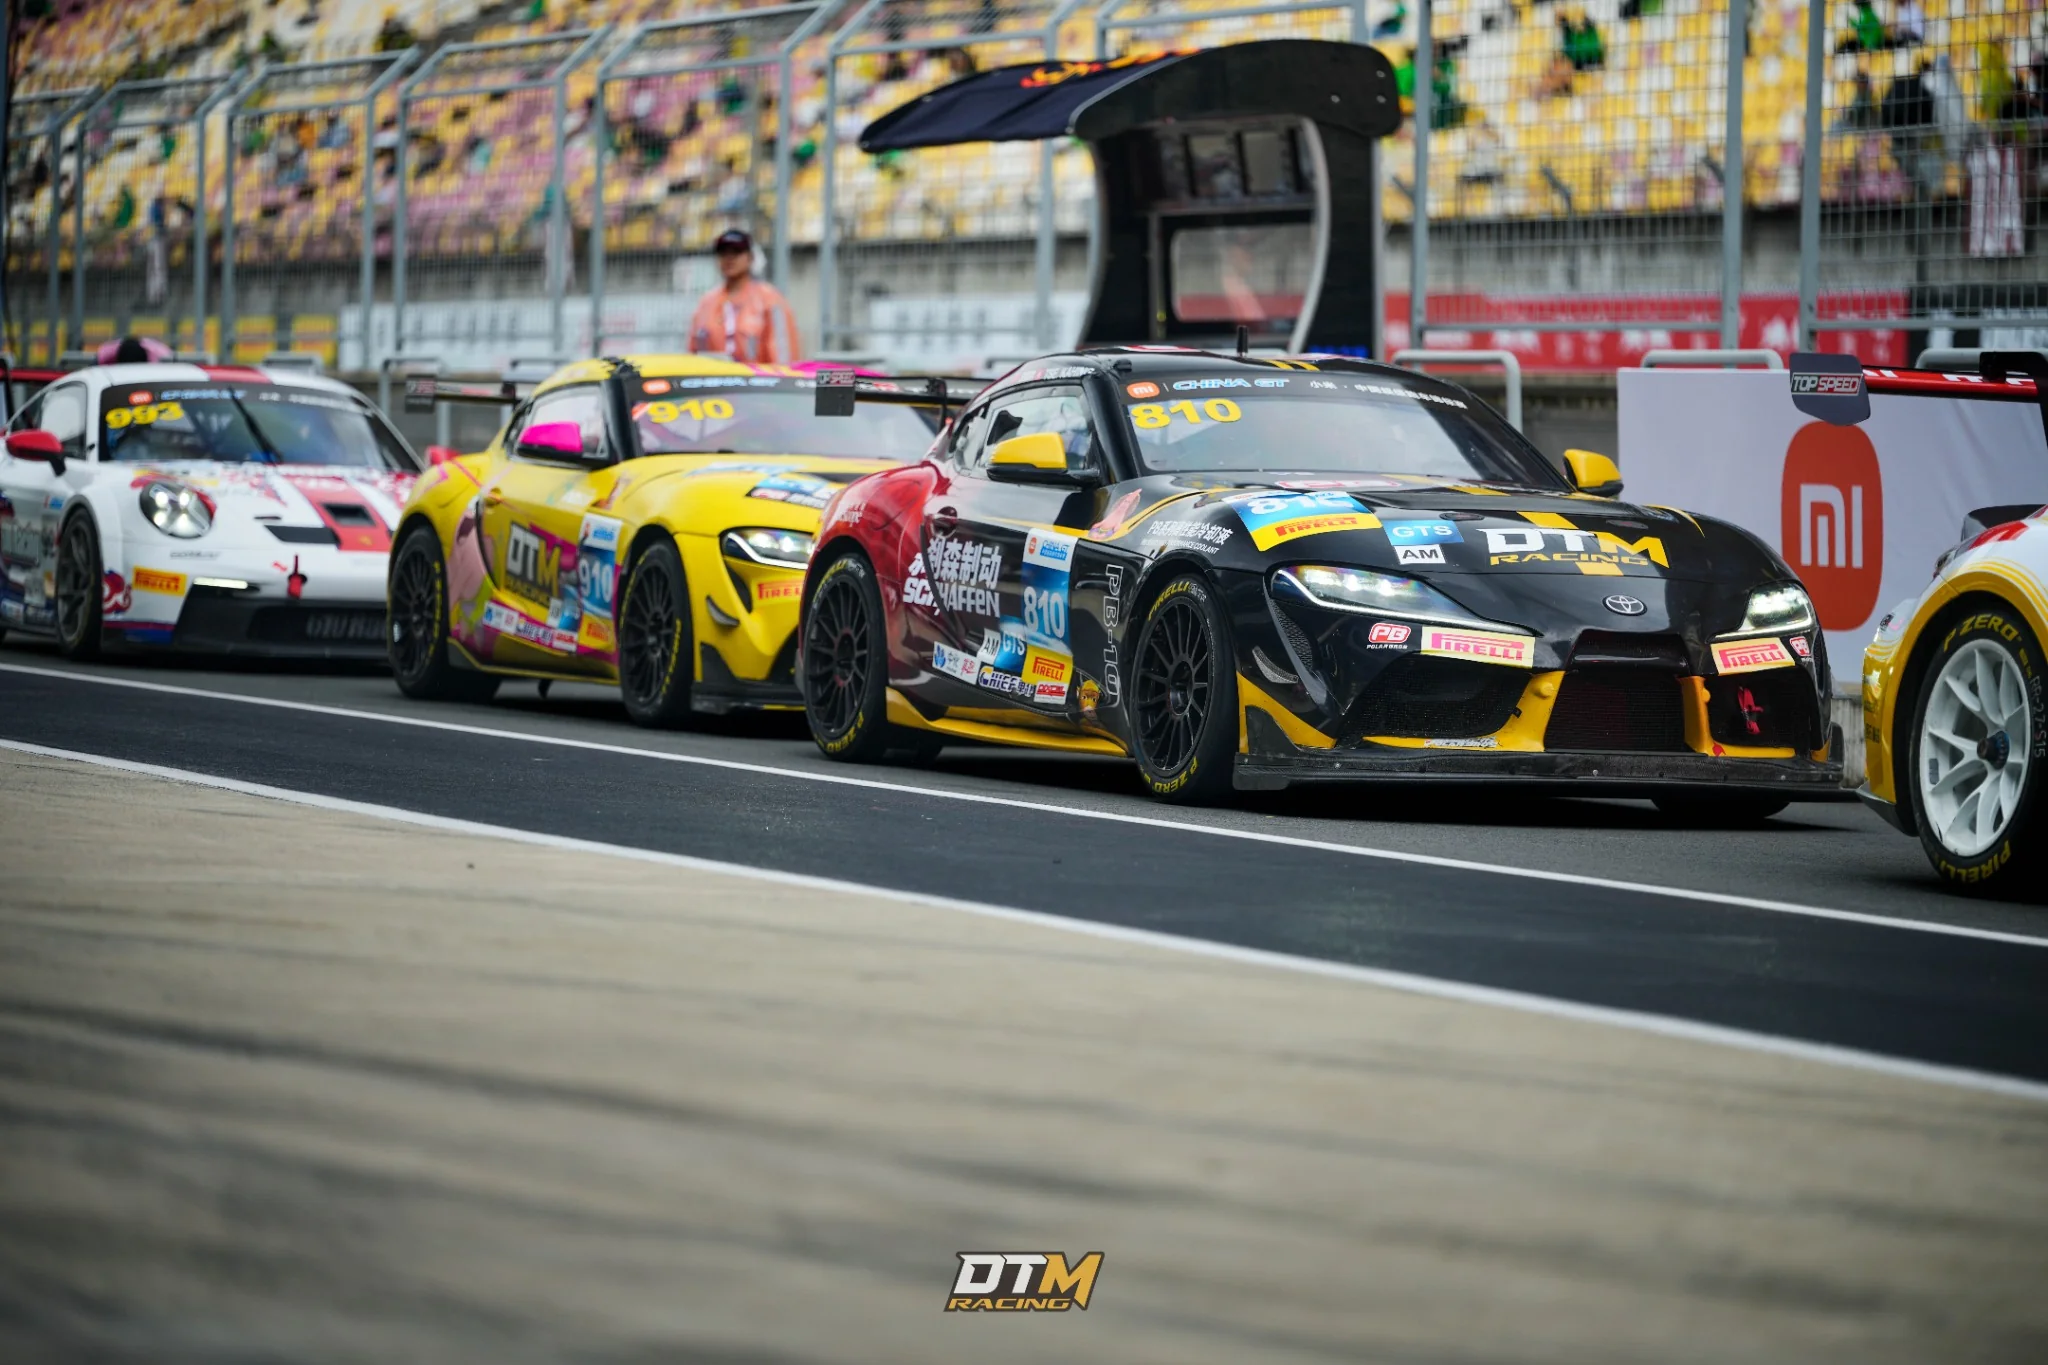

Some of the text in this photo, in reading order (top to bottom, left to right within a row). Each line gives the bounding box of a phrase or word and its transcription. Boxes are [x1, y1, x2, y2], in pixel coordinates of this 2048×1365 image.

[1173, 378, 1290, 391] CHINA GT
[1793, 376, 1861, 393] TOP SPEED
[105, 401, 185, 430] 993
[647, 398, 735, 424] 910
[1130, 398, 1242, 430] 810
[1275, 517, 1358, 537] PIRELLI
[1392, 524, 1453, 539] GTS
[506, 522, 562, 597] DTM
[1193, 541, 1220, 555] COOLANT
[1402, 549, 1439, 560] AM
[1476, 528, 1670, 569] DTM
[1490, 553, 1649, 566] RACING
[578, 558, 614, 604] 910
[1023, 585, 1066, 639] 810
[1148, 581, 1190, 622] PIRELLI
[1002, 630, 1025, 656] GTS
[1371, 624, 1408, 642] PB
[1943, 613, 2020, 653] P ZERO
[984, 637, 1000, 656] AM
[1431, 632, 1525, 661] PIRELLI
[1718, 643, 1786, 669] PIRELLI
[1032, 655, 1066, 681] PIRELLI
[1153, 756, 1199, 794] P ZERO
[1939, 840, 2012, 884] PIRELLI
